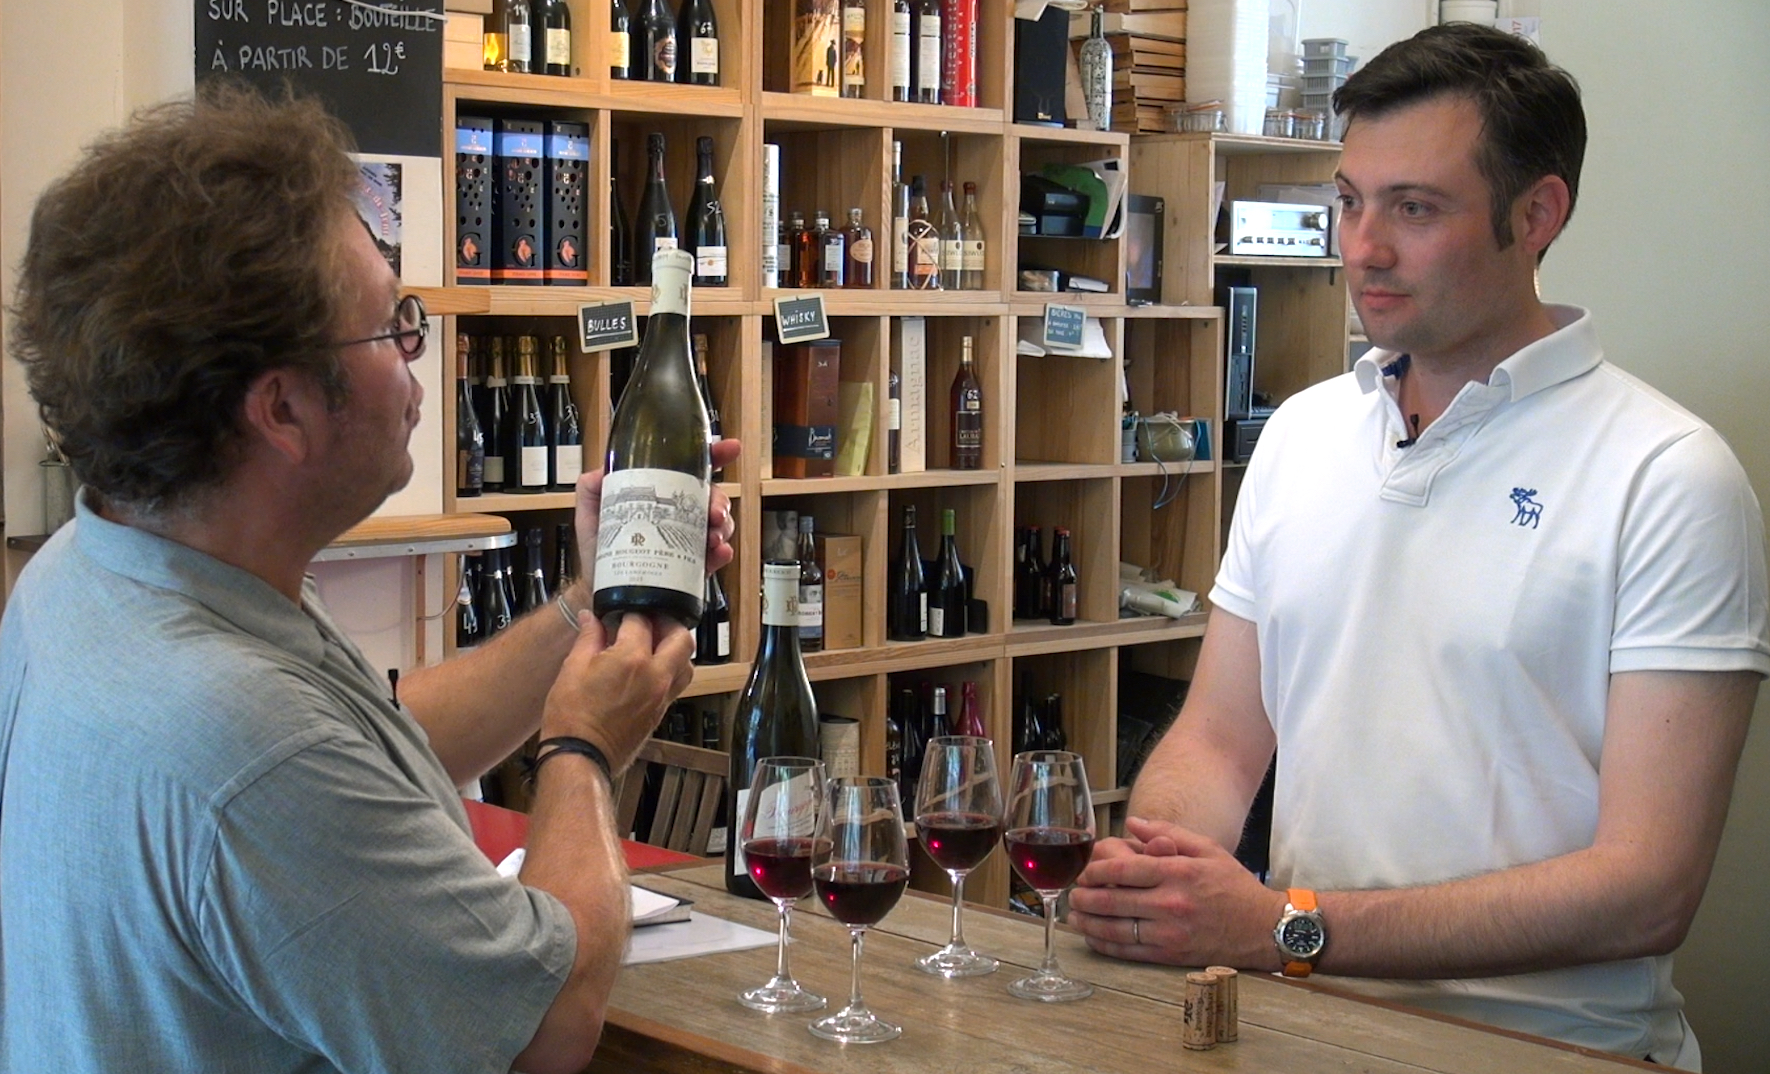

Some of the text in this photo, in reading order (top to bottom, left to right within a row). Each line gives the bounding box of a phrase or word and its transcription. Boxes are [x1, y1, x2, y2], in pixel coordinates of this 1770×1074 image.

[207, 0, 249, 23] SUR
[267, 2, 328, 27] PLACE
[348, 4, 437, 32] BOUTEILLE
[210, 40, 229, 72] À
[239, 46, 313, 72] PARTIR
[321, 46, 350, 71] DE
[587, 316, 627, 333] BULLES
[781, 310, 816, 327] WHISKY
[905, 336, 922, 454] Armagnac
[611, 561, 669, 570] BOURGOGNE
